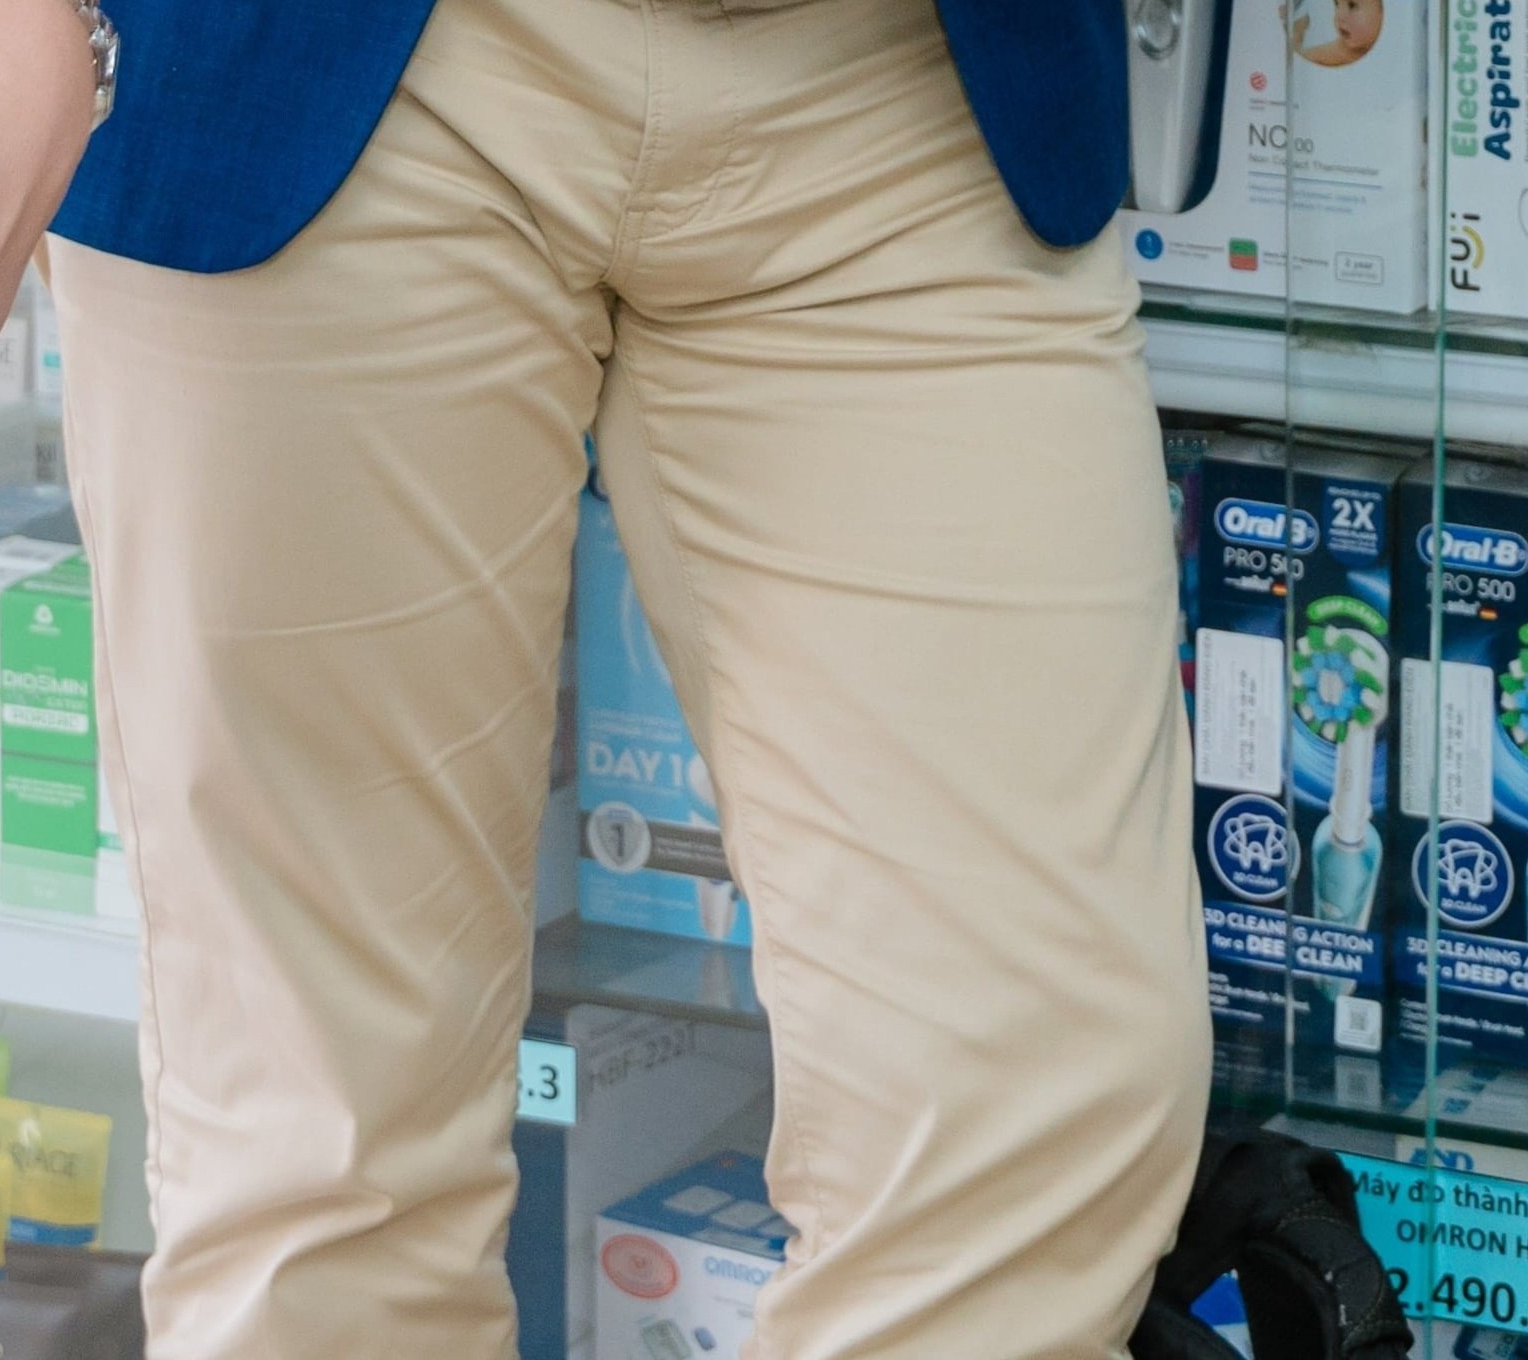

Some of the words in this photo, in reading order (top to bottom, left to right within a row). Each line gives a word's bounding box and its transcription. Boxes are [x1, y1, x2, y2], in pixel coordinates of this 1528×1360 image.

[1331, 497, 1374, 532] 2X
[587, 743, 661, 780] DAY
[1396, 1217, 1507, 1258] OMRON
